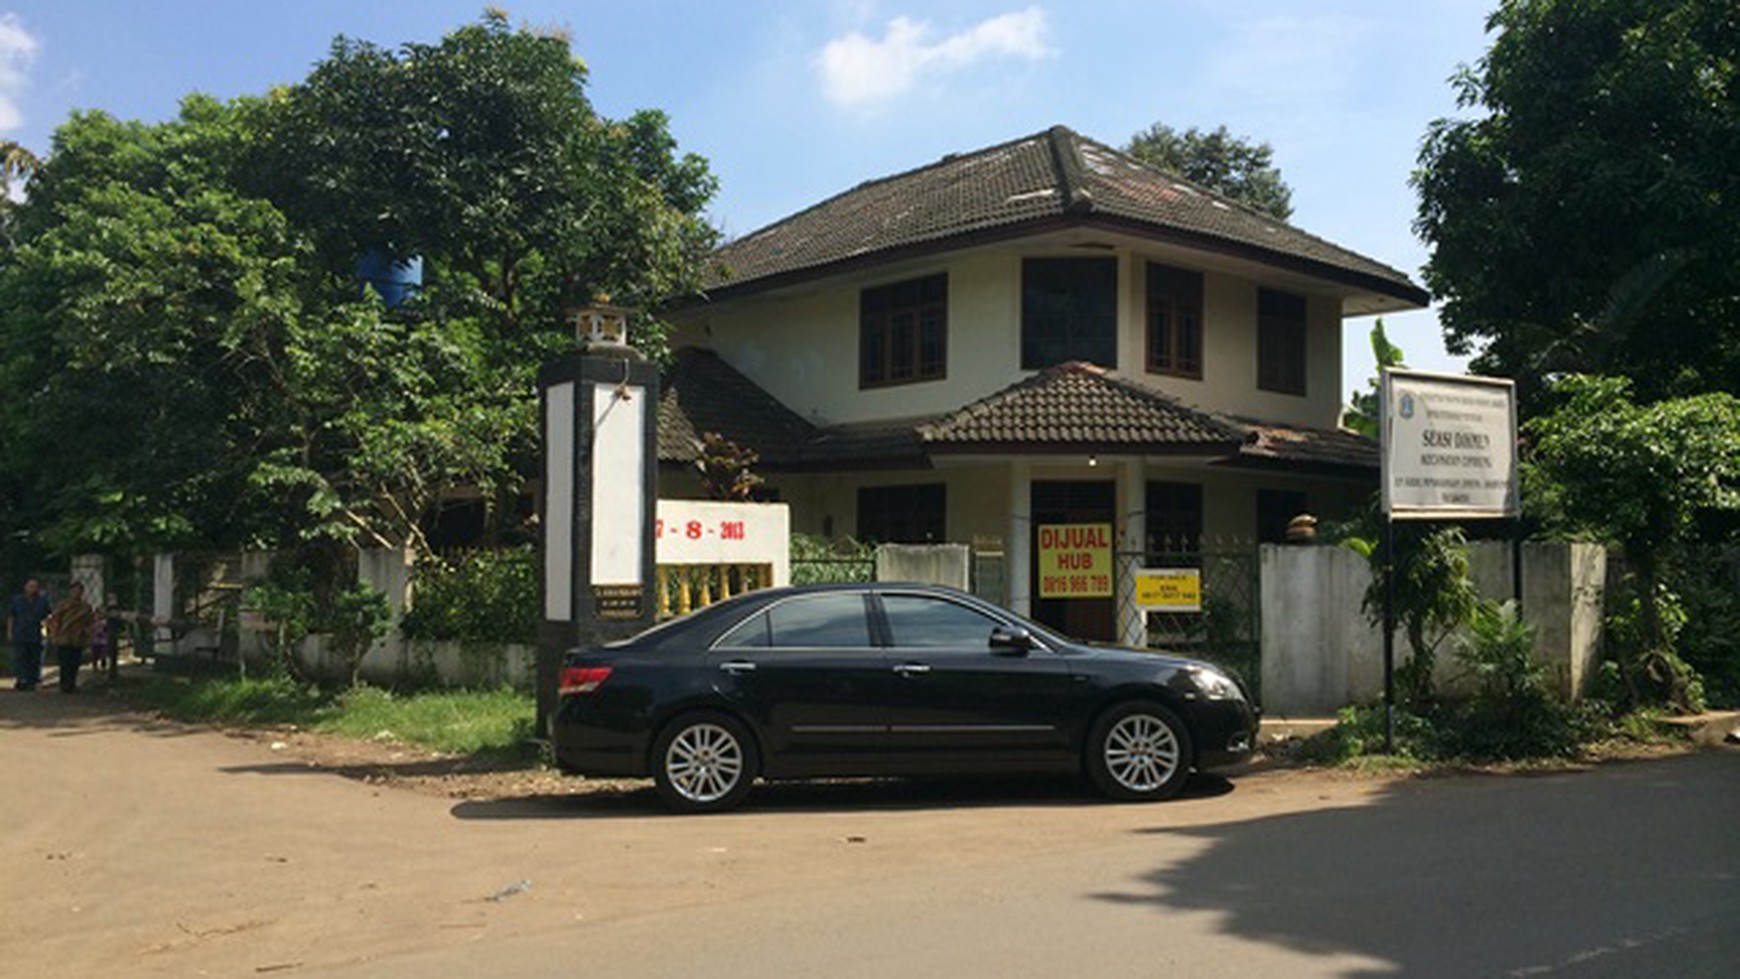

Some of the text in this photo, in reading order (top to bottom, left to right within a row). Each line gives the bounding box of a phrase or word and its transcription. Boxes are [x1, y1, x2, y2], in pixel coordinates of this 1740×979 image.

[686, 519, 702, 540] 8
[1041, 527, 1109, 550] DIJUAL
[1057, 553, 1094, 571] HUB
